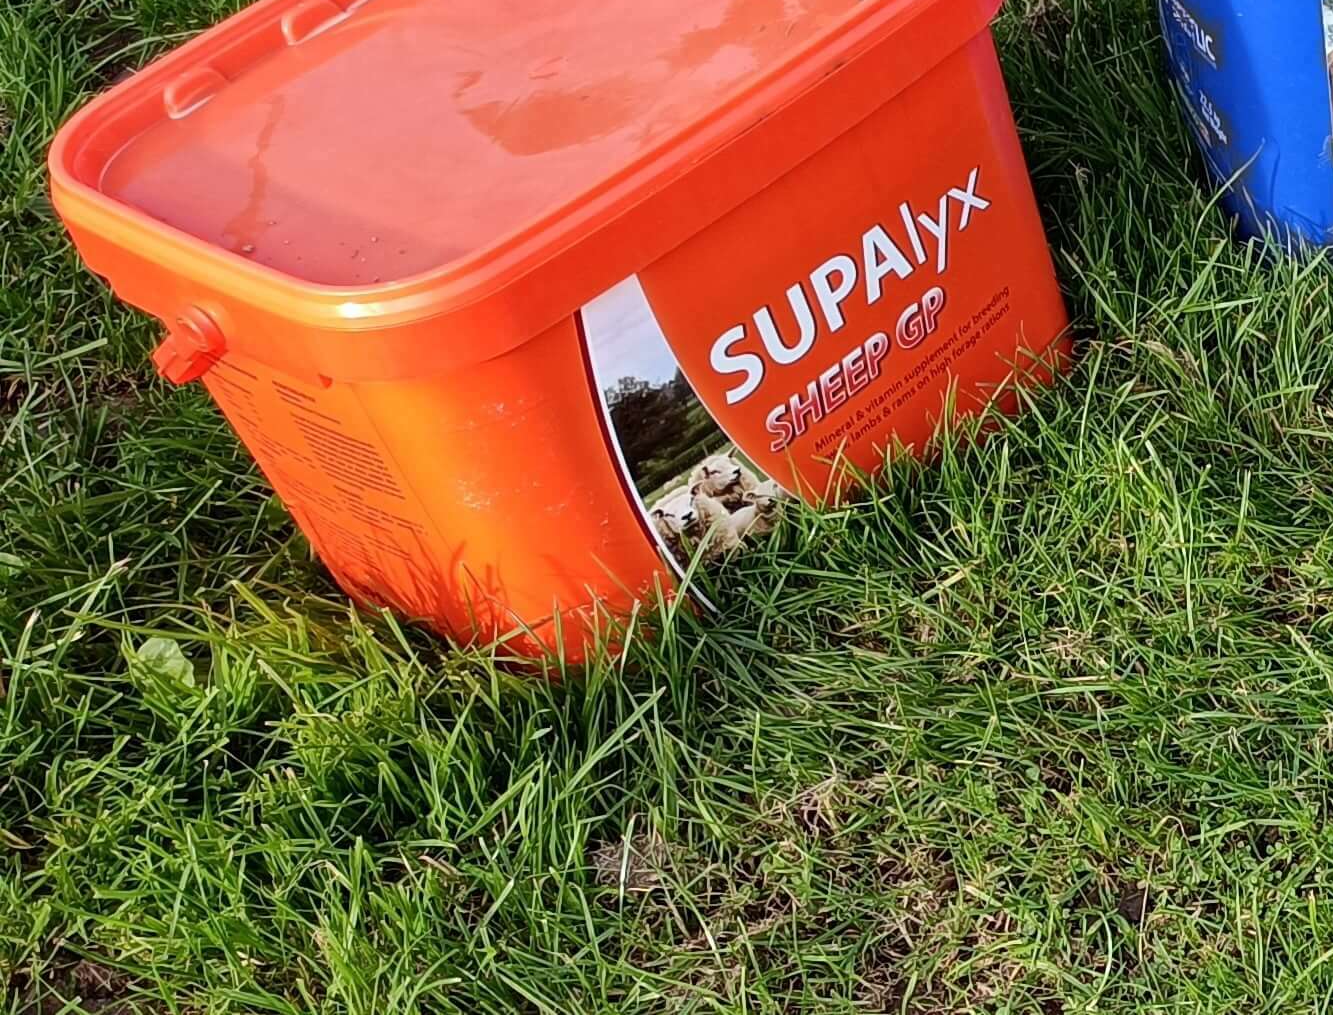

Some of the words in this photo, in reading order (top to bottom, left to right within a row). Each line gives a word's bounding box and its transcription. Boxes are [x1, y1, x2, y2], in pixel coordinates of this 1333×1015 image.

[709, 167, 992, 405] SUPAlyx
[815, 416, 855, 452] Mineral
[856, 410, 865, 421] &
[865, 381, 903, 414] vitamin
[903, 332, 959, 385] supplement
[958, 322, 971, 338] for
[972, 286, 1010, 323] breeding
[764, 331, 890, 453] SHEEP
[895, 286, 945, 350] GP
[849, 414, 882, 444] lambs
[882, 406, 891, 418] &
[891, 386, 917, 410] rams
[917, 375, 930, 390] on
[930, 357, 952, 380] high
[952, 332, 982, 361] forage
[981, 303, 1010, 335] rations
